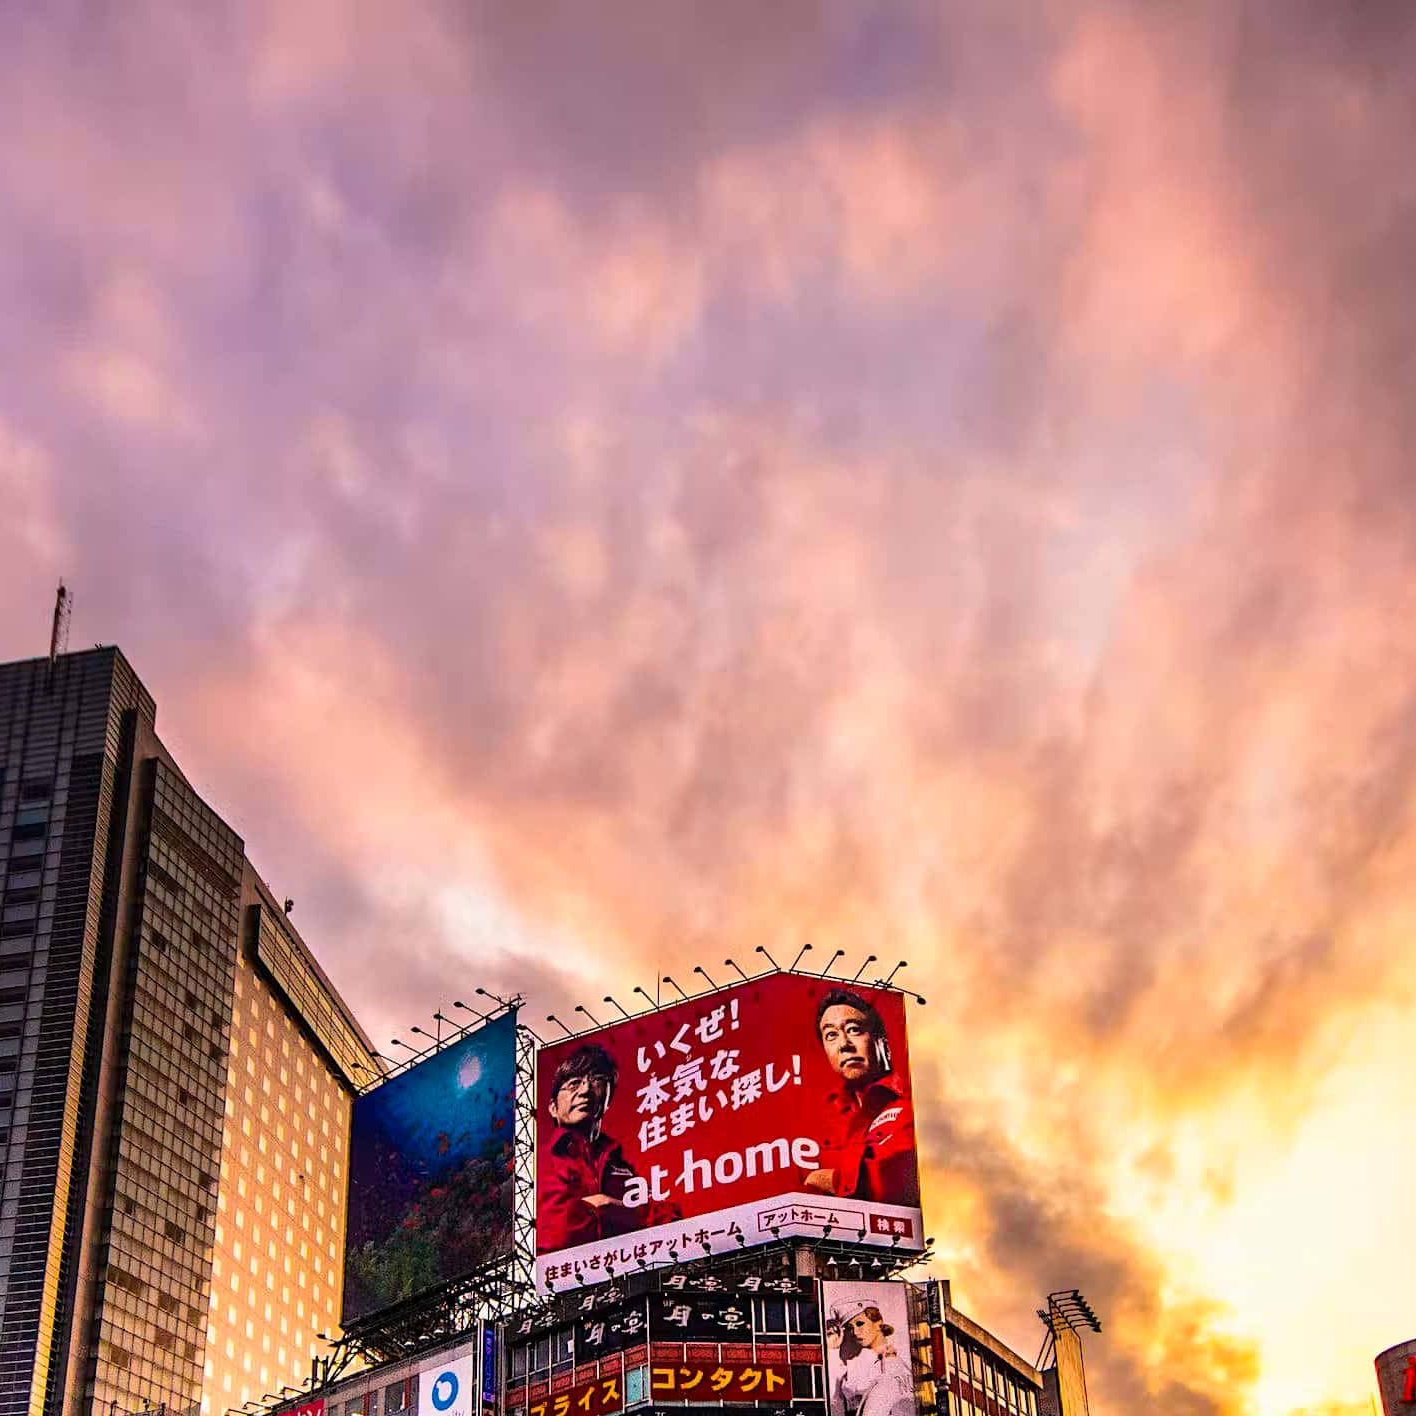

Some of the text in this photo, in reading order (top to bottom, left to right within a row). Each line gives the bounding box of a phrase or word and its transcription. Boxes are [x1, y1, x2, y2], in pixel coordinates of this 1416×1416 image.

[636, 998, 740, 1073] いくぜ!
[636, 1048, 740, 1116] 本気な
[637, 1054, 802, 1152] 住まい探し!
[622, 1136, 820, 1209] at home
[763, 1208, 840, 1227] アットホーム
[544, 1220, 743, 1284] 住まいさがしはアットホーム
[652, 1366, 785, 1392] コンタクト
